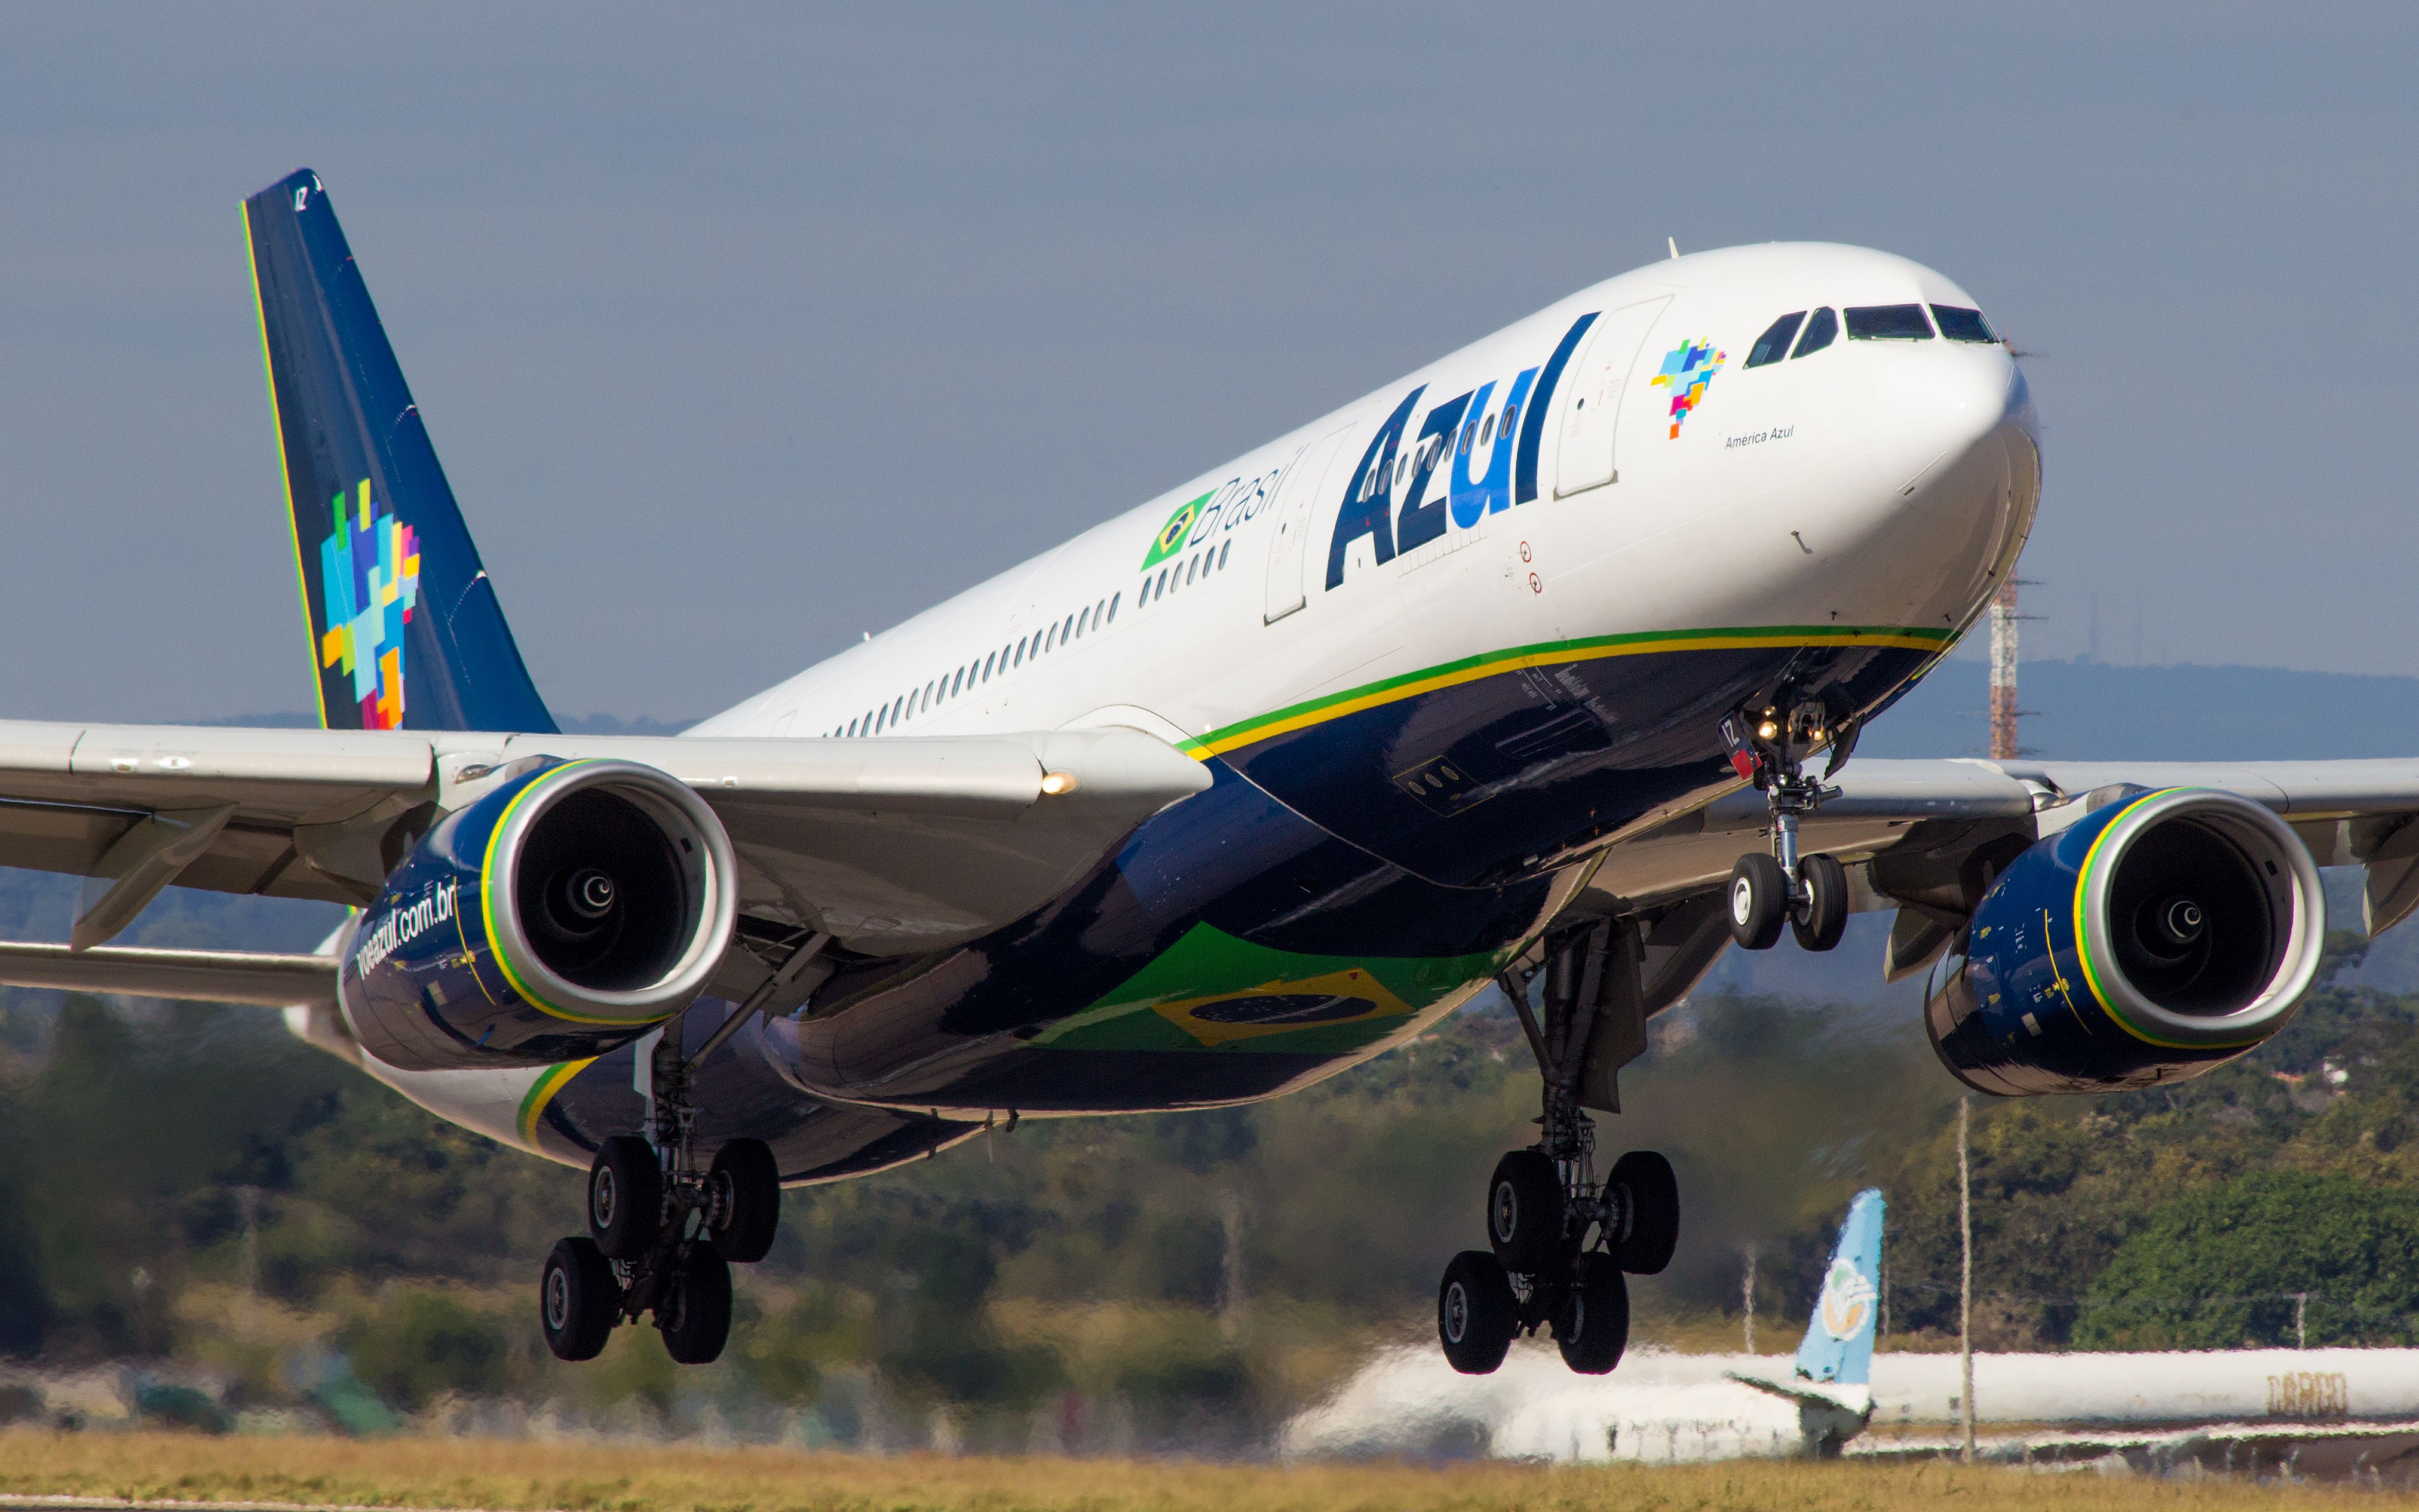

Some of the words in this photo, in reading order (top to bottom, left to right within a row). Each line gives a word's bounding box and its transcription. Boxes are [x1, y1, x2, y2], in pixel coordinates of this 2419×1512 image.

[1325, 311, 1604, 593] Azul
[1725, 432, 1767, 450] América
[1770, 425, 1794, 441] Azul
[1188, 443, 1311, 548] Brasil
[356, 882, 455, 980] voeazul.com.br
